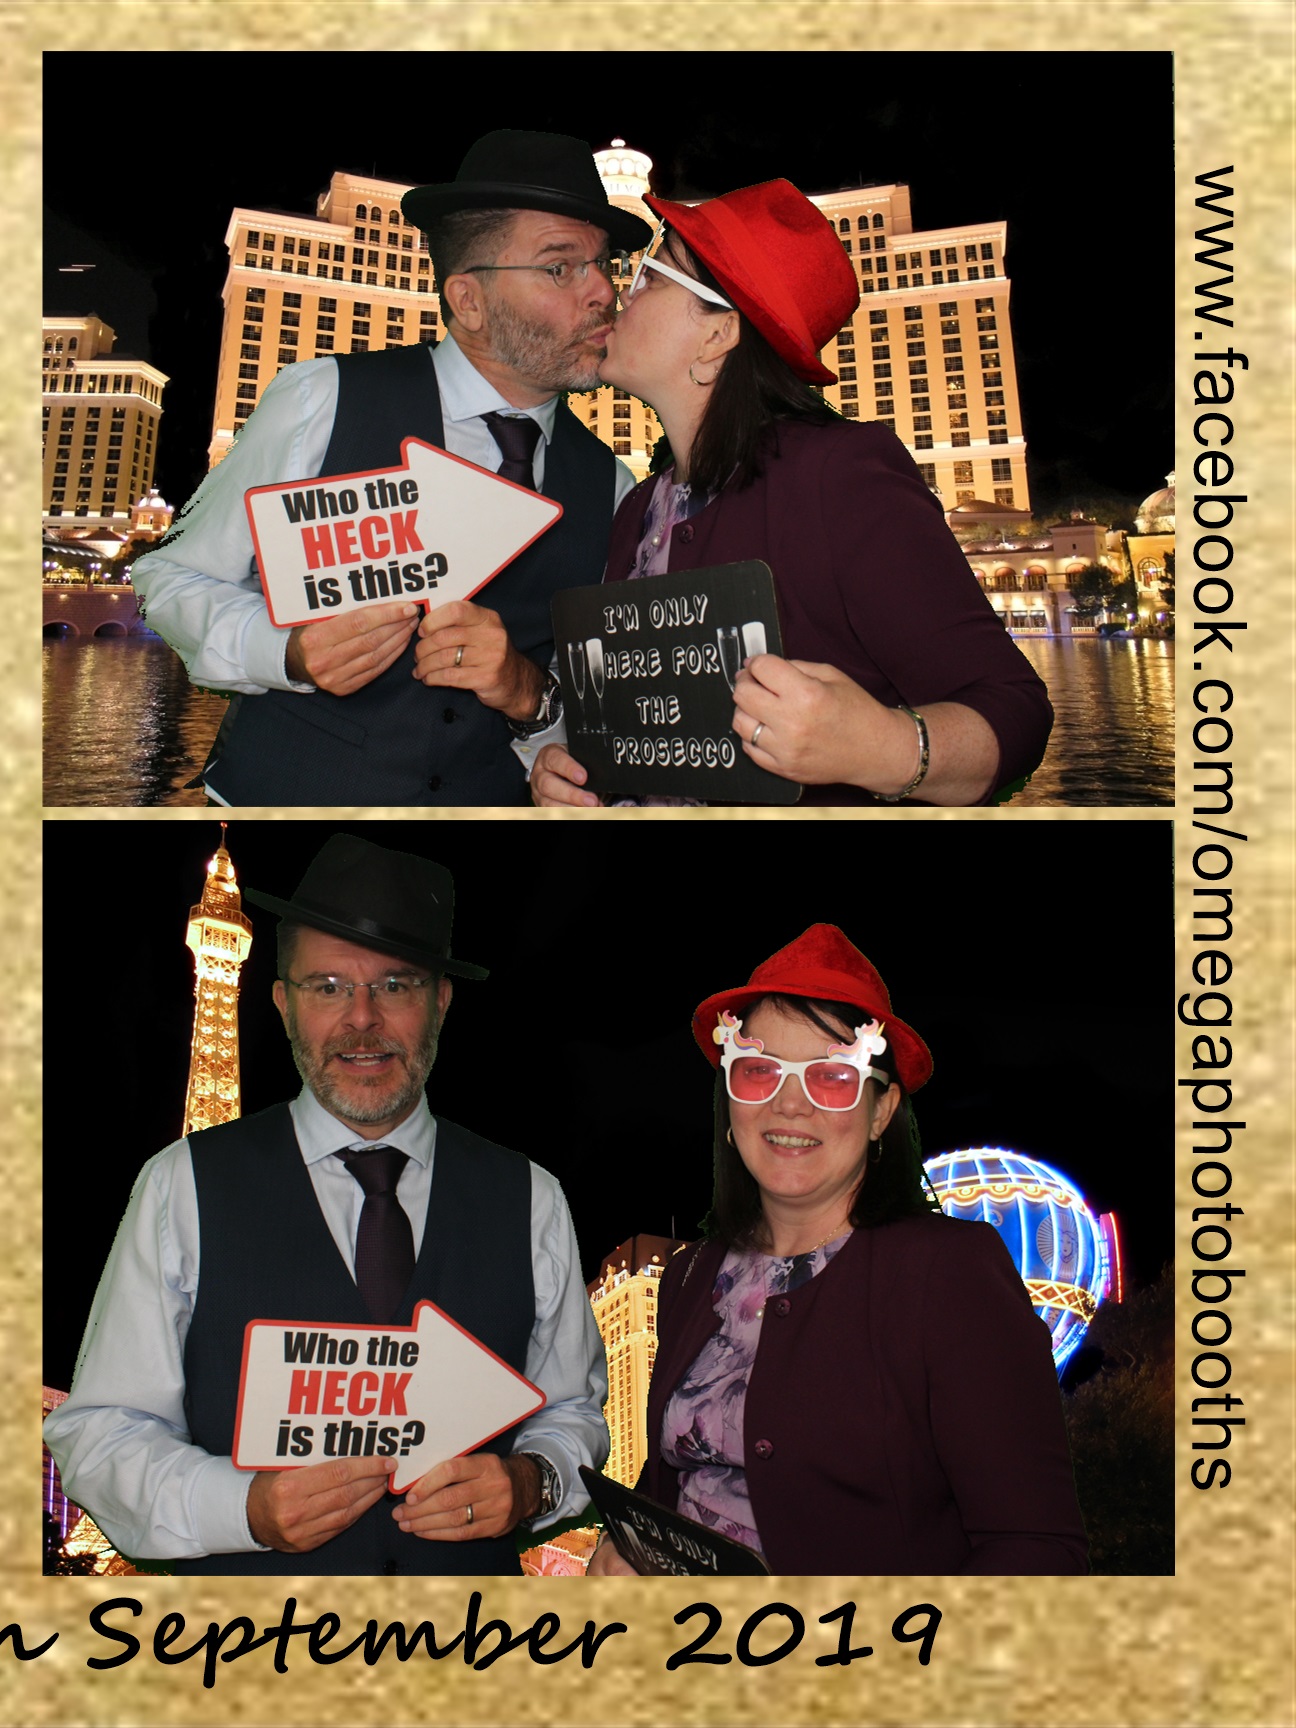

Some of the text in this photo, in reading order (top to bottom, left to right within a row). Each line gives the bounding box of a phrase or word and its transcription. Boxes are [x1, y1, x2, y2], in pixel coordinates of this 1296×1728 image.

[281, 478, 419, 524] Who the
[301, 509, 425, 571] HECK
[303, 552, 449, 610] is this?
[603, 593, 708, 634] I'M ONLY
[604, 643, 721, 679] HERE FOR
[635, 695, 681, 725] THE
[613, 736, 736, 769] PROSECCO
[283, 1330, 420, 1367] Who the
[287, 1369, 413, 1417] HECK
[275, 1420, 426, 1457] is this?
[666, 1527, 719, 1571] ONLY
